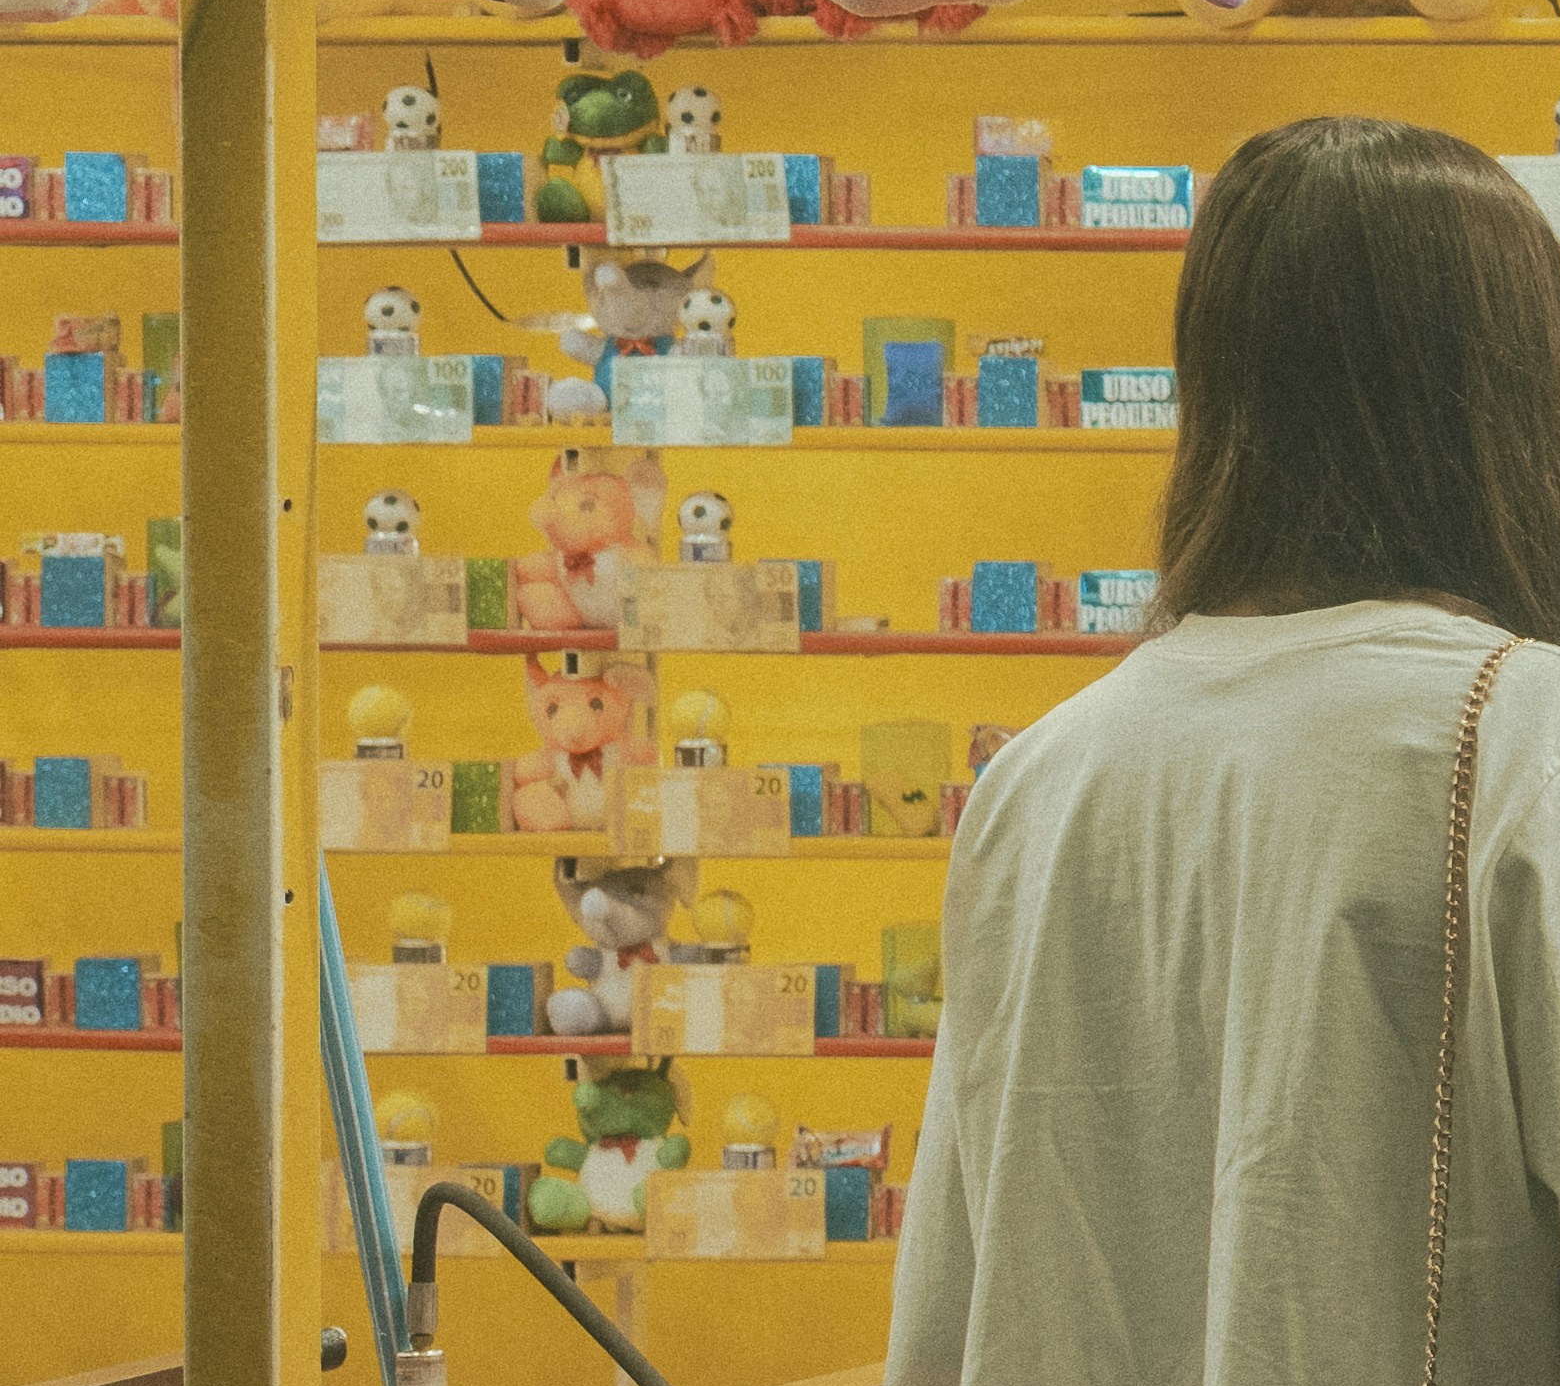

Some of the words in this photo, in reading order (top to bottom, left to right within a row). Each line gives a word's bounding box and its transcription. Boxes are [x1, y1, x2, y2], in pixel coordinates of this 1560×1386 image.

[1081, 402, 1178, 429] PEQUEN
[1100, 578, 1159, 607] URS
[417, 770, 443, 790] 20
[754, 776, 781, 797] 20
[453, 972, 480, 992] 20
[780, 974, 807, 994] 20
[789, 1177, 816, 1198] 20
